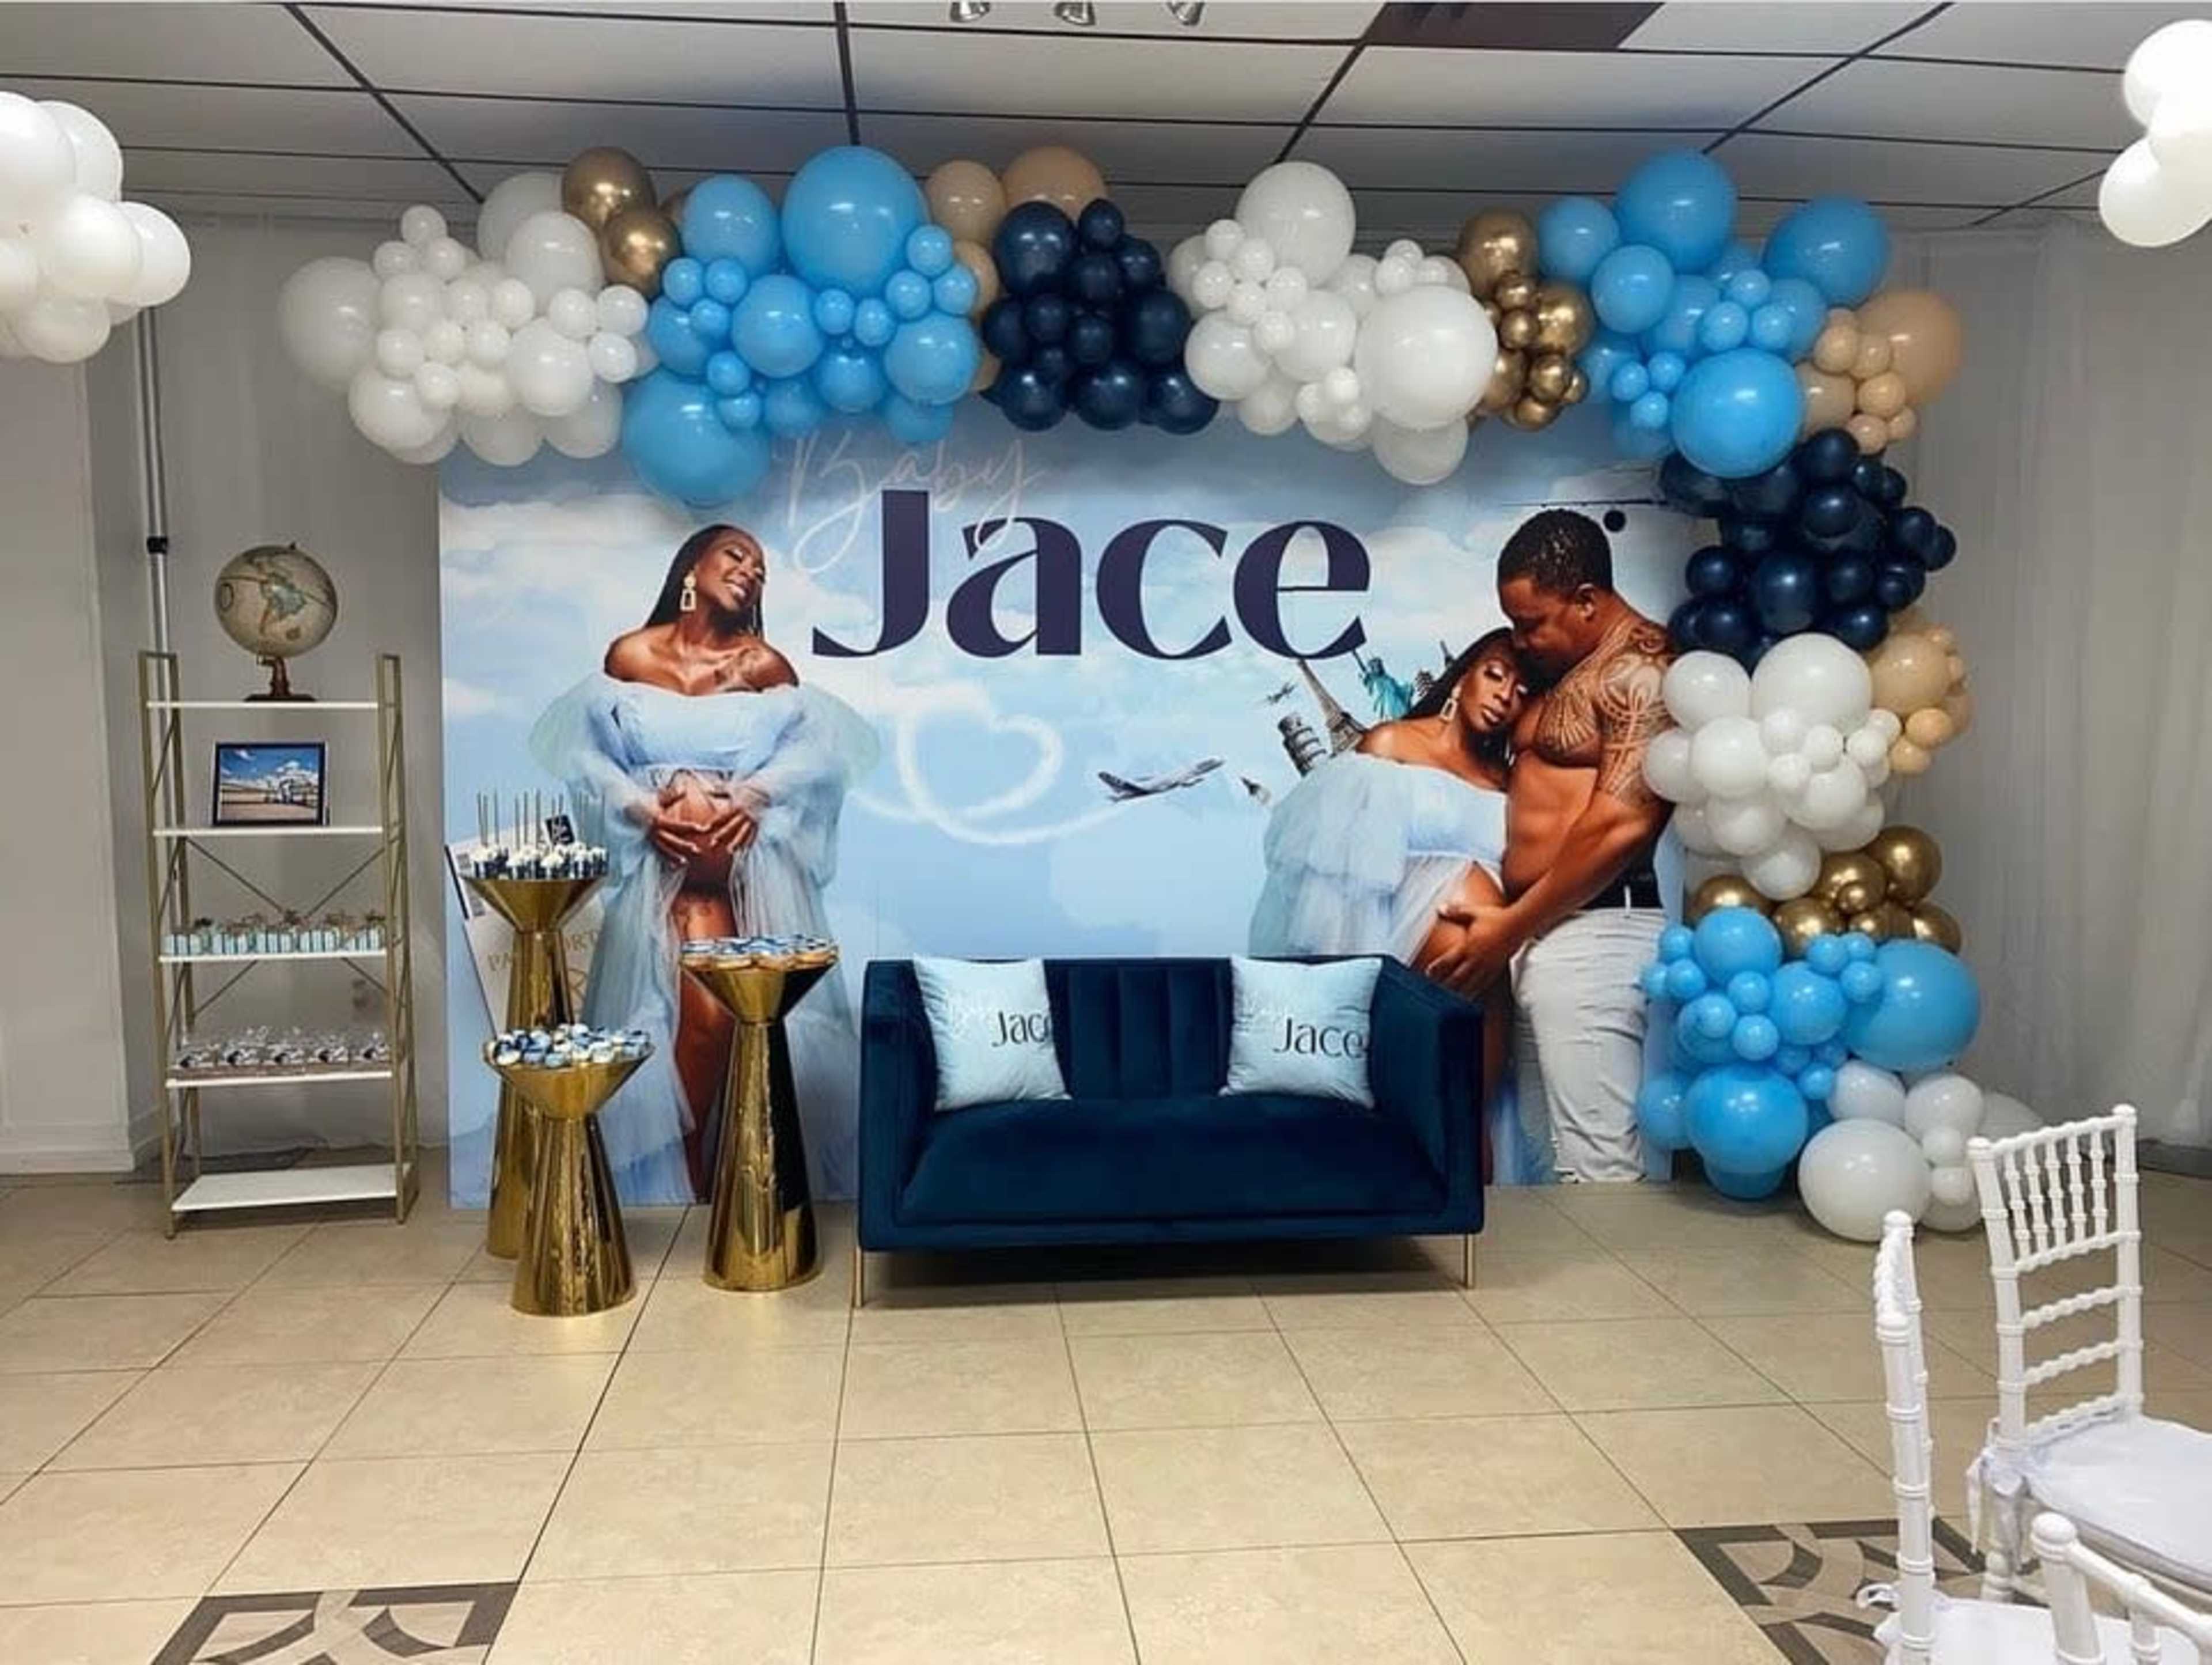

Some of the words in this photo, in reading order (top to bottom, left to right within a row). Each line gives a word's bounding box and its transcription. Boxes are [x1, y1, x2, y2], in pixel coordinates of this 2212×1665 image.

[781, 430, 1046, 574] Baby
[813, 489, 1370, 660] Jace
[1272, 1017, 1363, 1059] Jace
